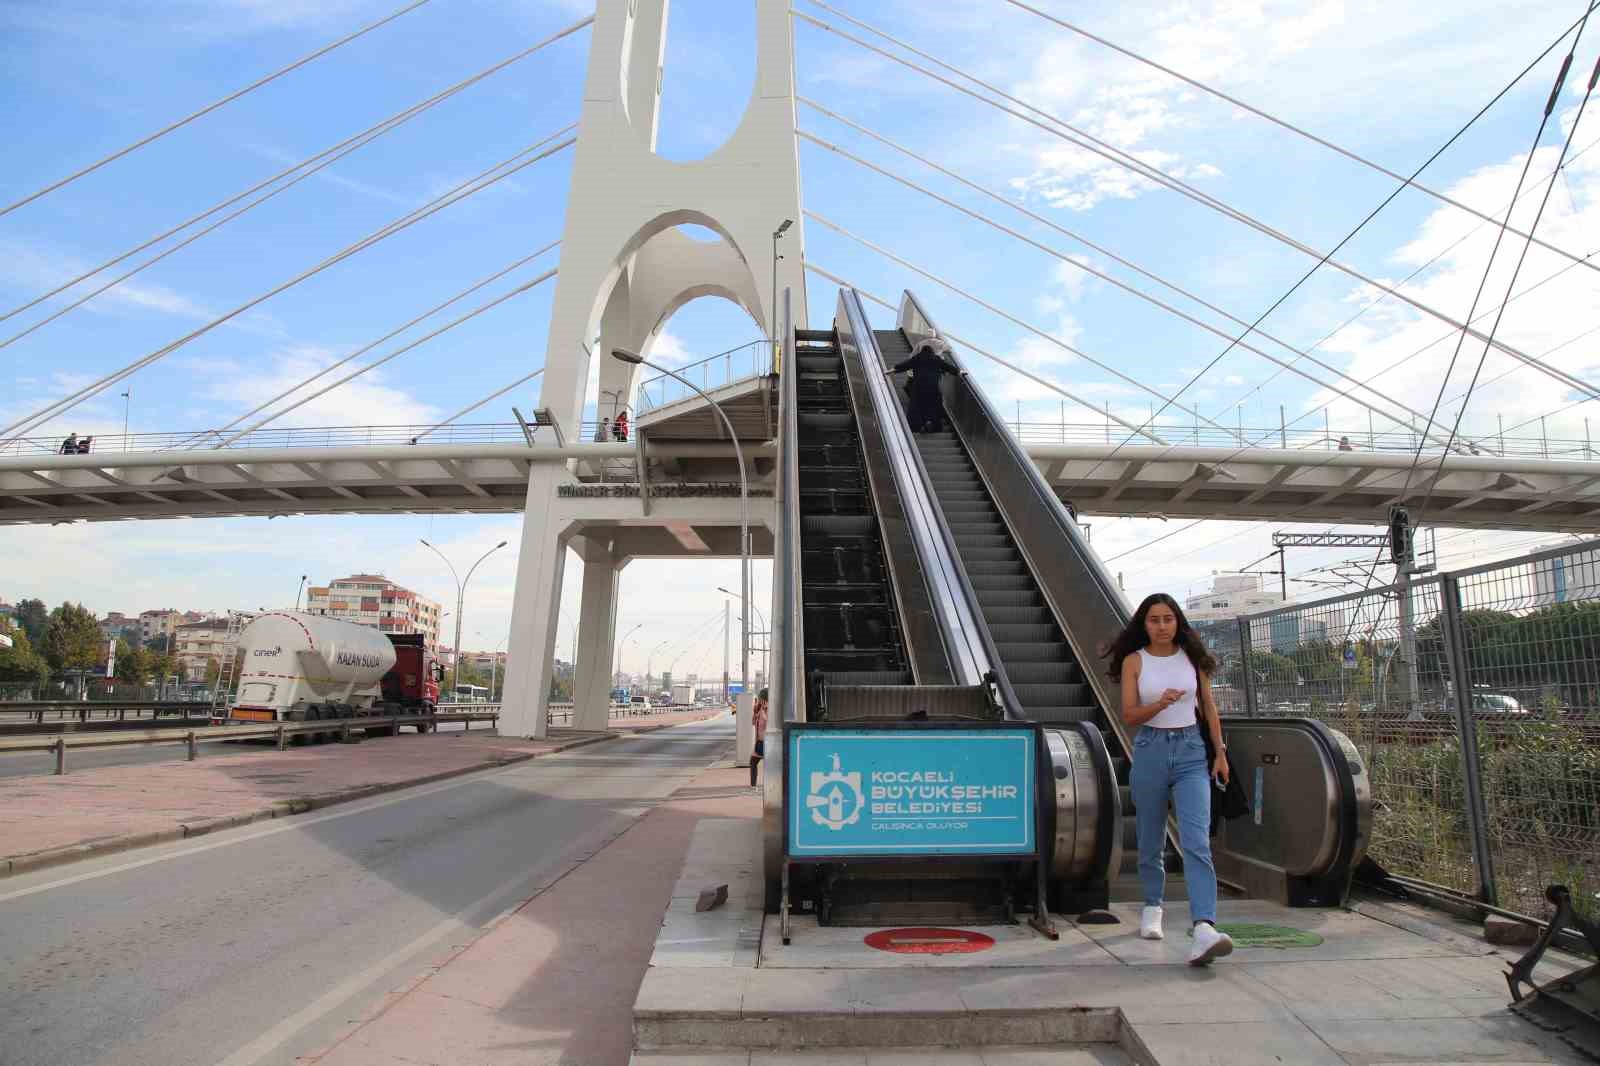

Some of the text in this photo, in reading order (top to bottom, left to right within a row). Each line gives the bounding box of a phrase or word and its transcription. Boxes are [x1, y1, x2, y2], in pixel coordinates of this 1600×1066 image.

[871, 771, 953, 783] KOCAELİ
[871, 785, 1017, 800] BÜYÜKŞEHİR
[871, 801, 982, 814] BELEDİYESİ
